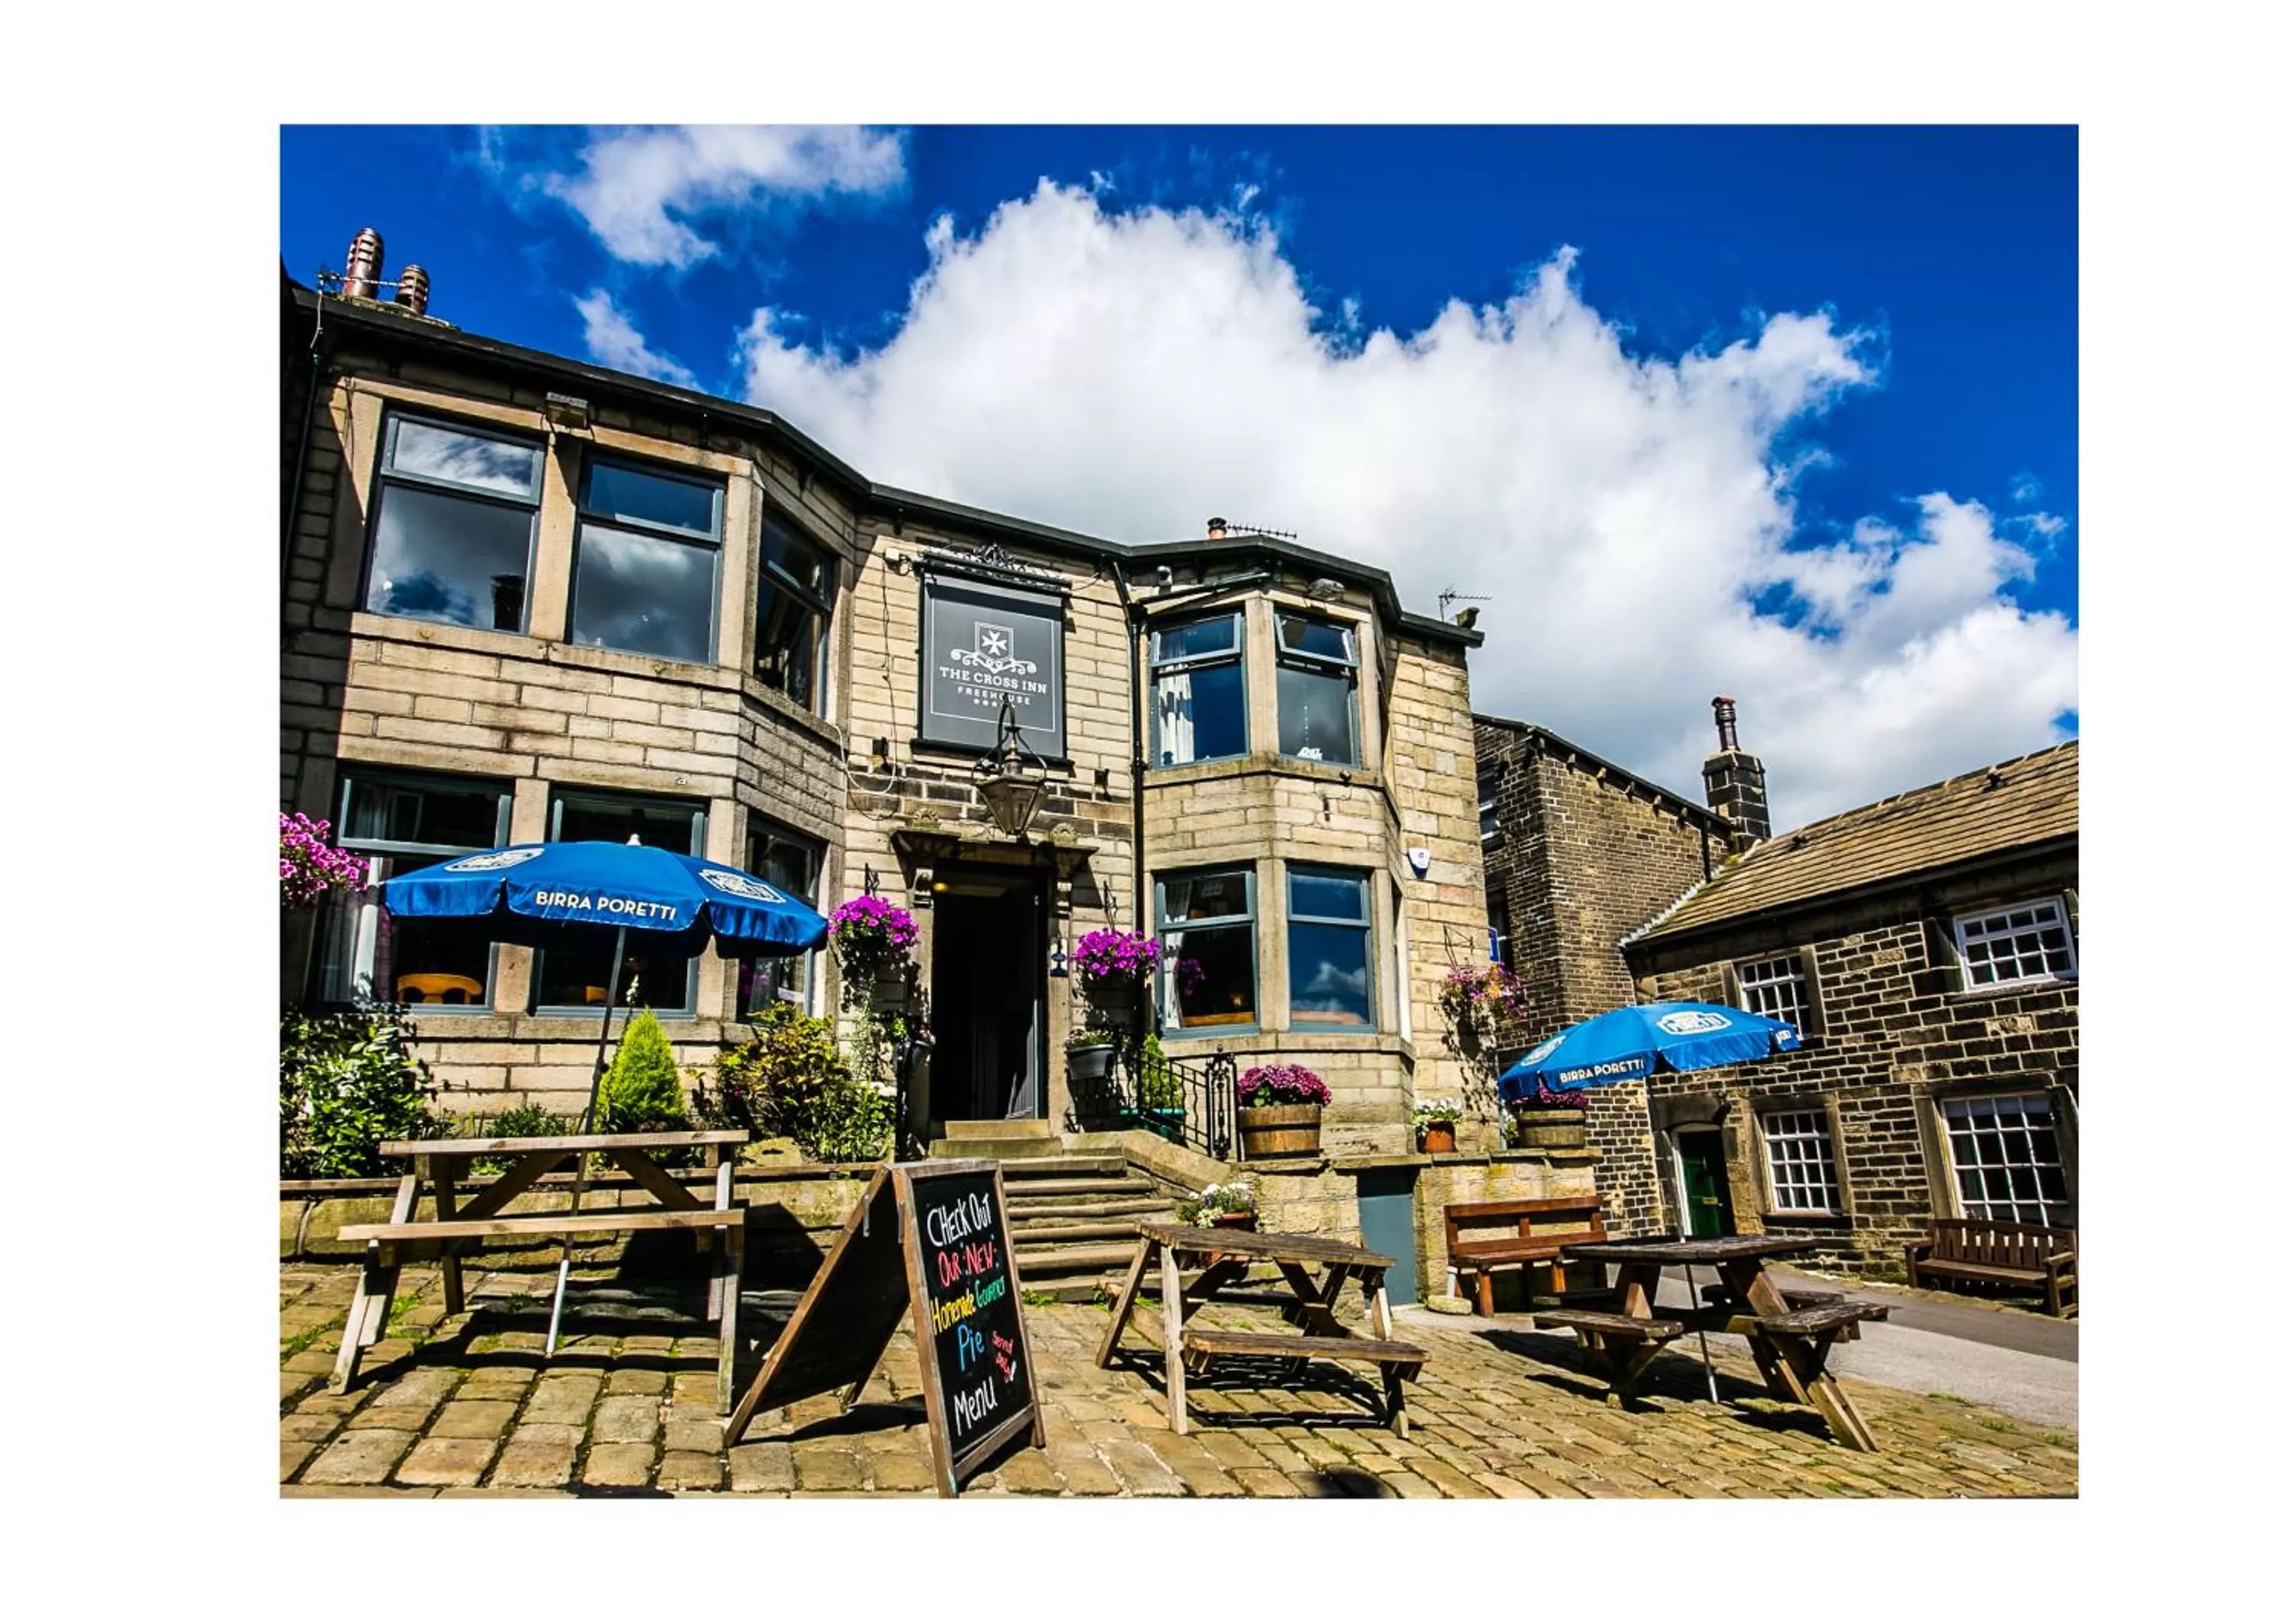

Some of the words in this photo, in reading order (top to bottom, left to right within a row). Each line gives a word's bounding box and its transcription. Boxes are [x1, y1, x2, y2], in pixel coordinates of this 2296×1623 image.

[939, 665, 970, 681] THE
[973, 671, 1019, 689] CROSS
[1022, 680, 1048, 694] INN
[536, 890, 592, 910] BIRRA
[596, 896, 677, 921] PORETTI
[1560, 1069, 1594, 1083] BIRRA
[1594, 1059, 1645, 1076] PORETTI
[965, 1241, 993, 1275] NEW
[957, 1324, 985, 1372] Pie
